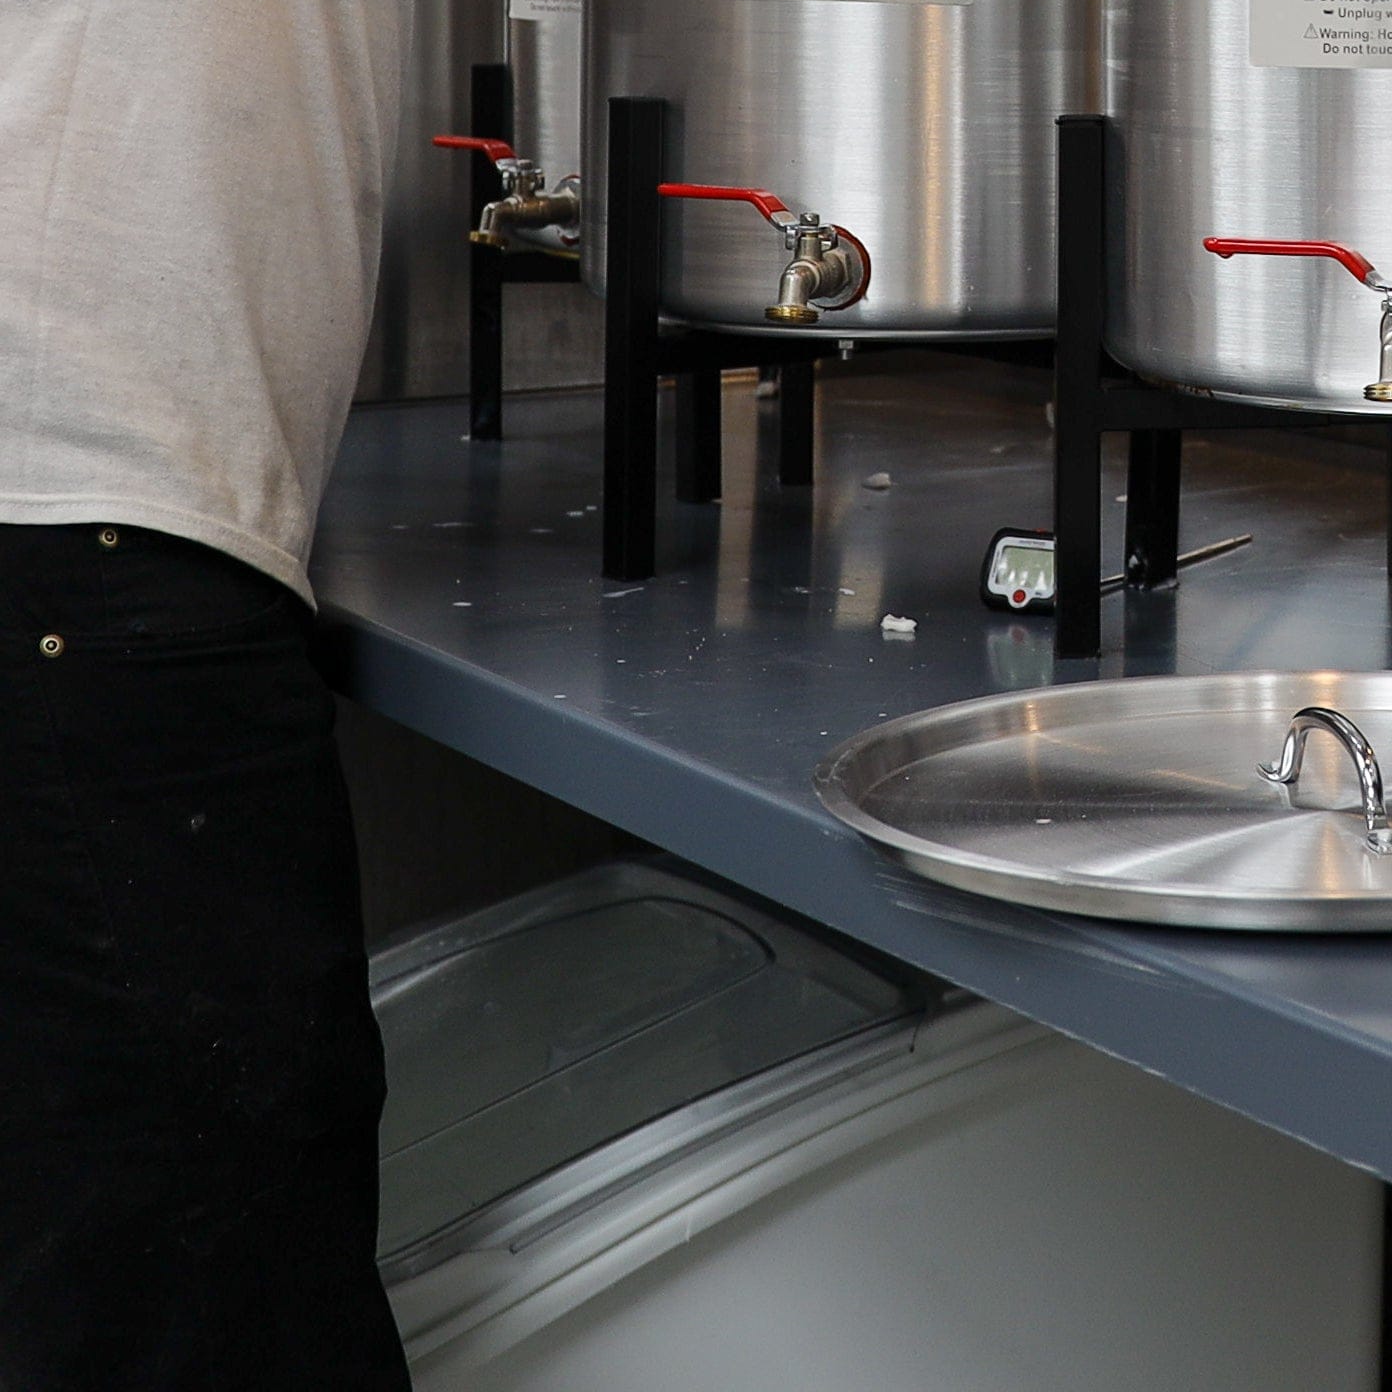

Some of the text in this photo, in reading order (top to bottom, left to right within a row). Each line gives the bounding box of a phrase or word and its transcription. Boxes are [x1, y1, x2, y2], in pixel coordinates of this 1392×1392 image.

[1337, 7, 1382, 20] Unplug
[1318, 28, 1373, 41] Warning:
[1322, 42, 1340, 54] Do
[1342, 44, 1363, 54] not
